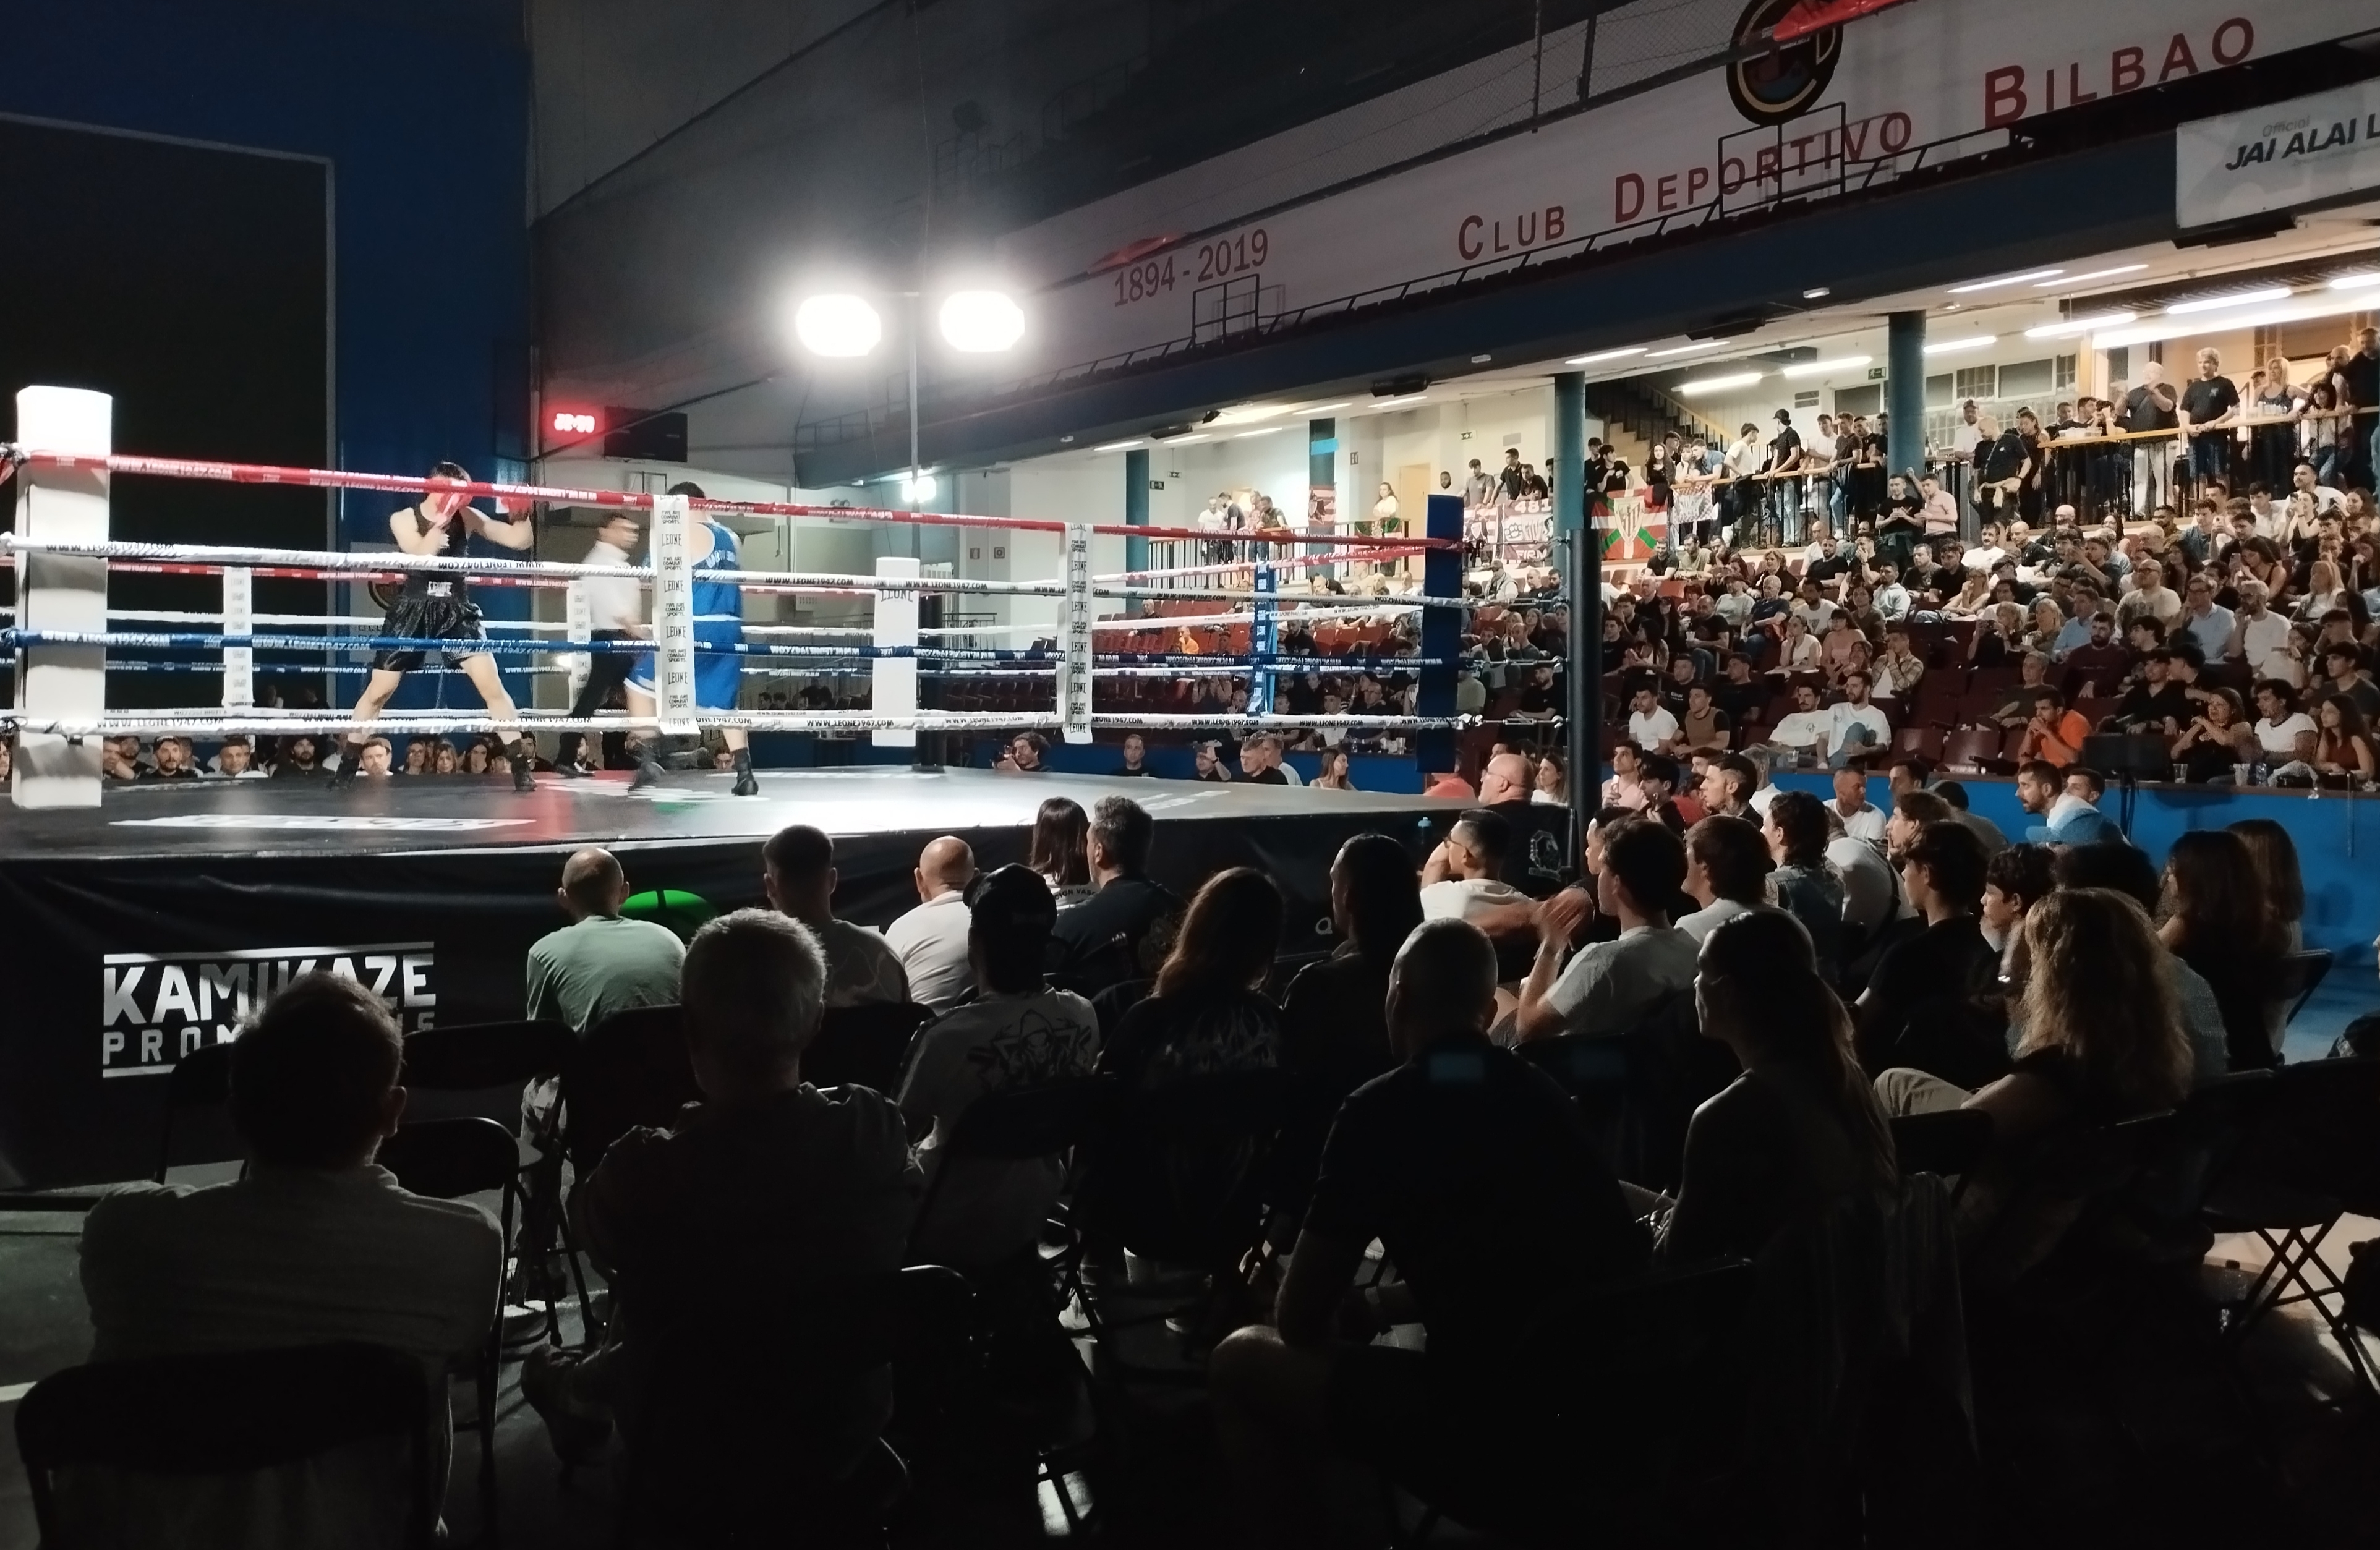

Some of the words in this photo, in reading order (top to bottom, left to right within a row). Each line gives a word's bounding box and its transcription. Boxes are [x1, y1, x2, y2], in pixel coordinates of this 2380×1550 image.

[1458, 205, 1566, 260] CLUB
[1615, 111, 1912, 223] DEPORTIVO
[1984, 16, 2255, 128] BILBAO
[2225, 138, 2277, 171] JAI
[2281, 118, 2357, 158] ALAI
[1114, 255, 1175, 307] 1894
[1198, 229, 1268, 283] 2019
[662, 534, 682, 547] LEONE
[1071, 560, 1086, 573] LEONE
[664, 580, 684, 593] LEONE
[765, 577, 854, 586] WWW.LEONE1947.COM
[905, 580, 987, 589] WWW.LEONE1947.COM
[1072, 601, 1087, 613] LEONE
[666, 626, 686, 639] LEONE
[1071, 642, 1087, 654] LEONE
[668, 671, 688, 685] LEONE
[1070, 682, 1086, 694] LEONE
[669, 718, 689, 727] LEONE
[806, 717, 894, 727] WWW.LEONE1947.COM
[1070, 723, 1086, 733] LEONE
